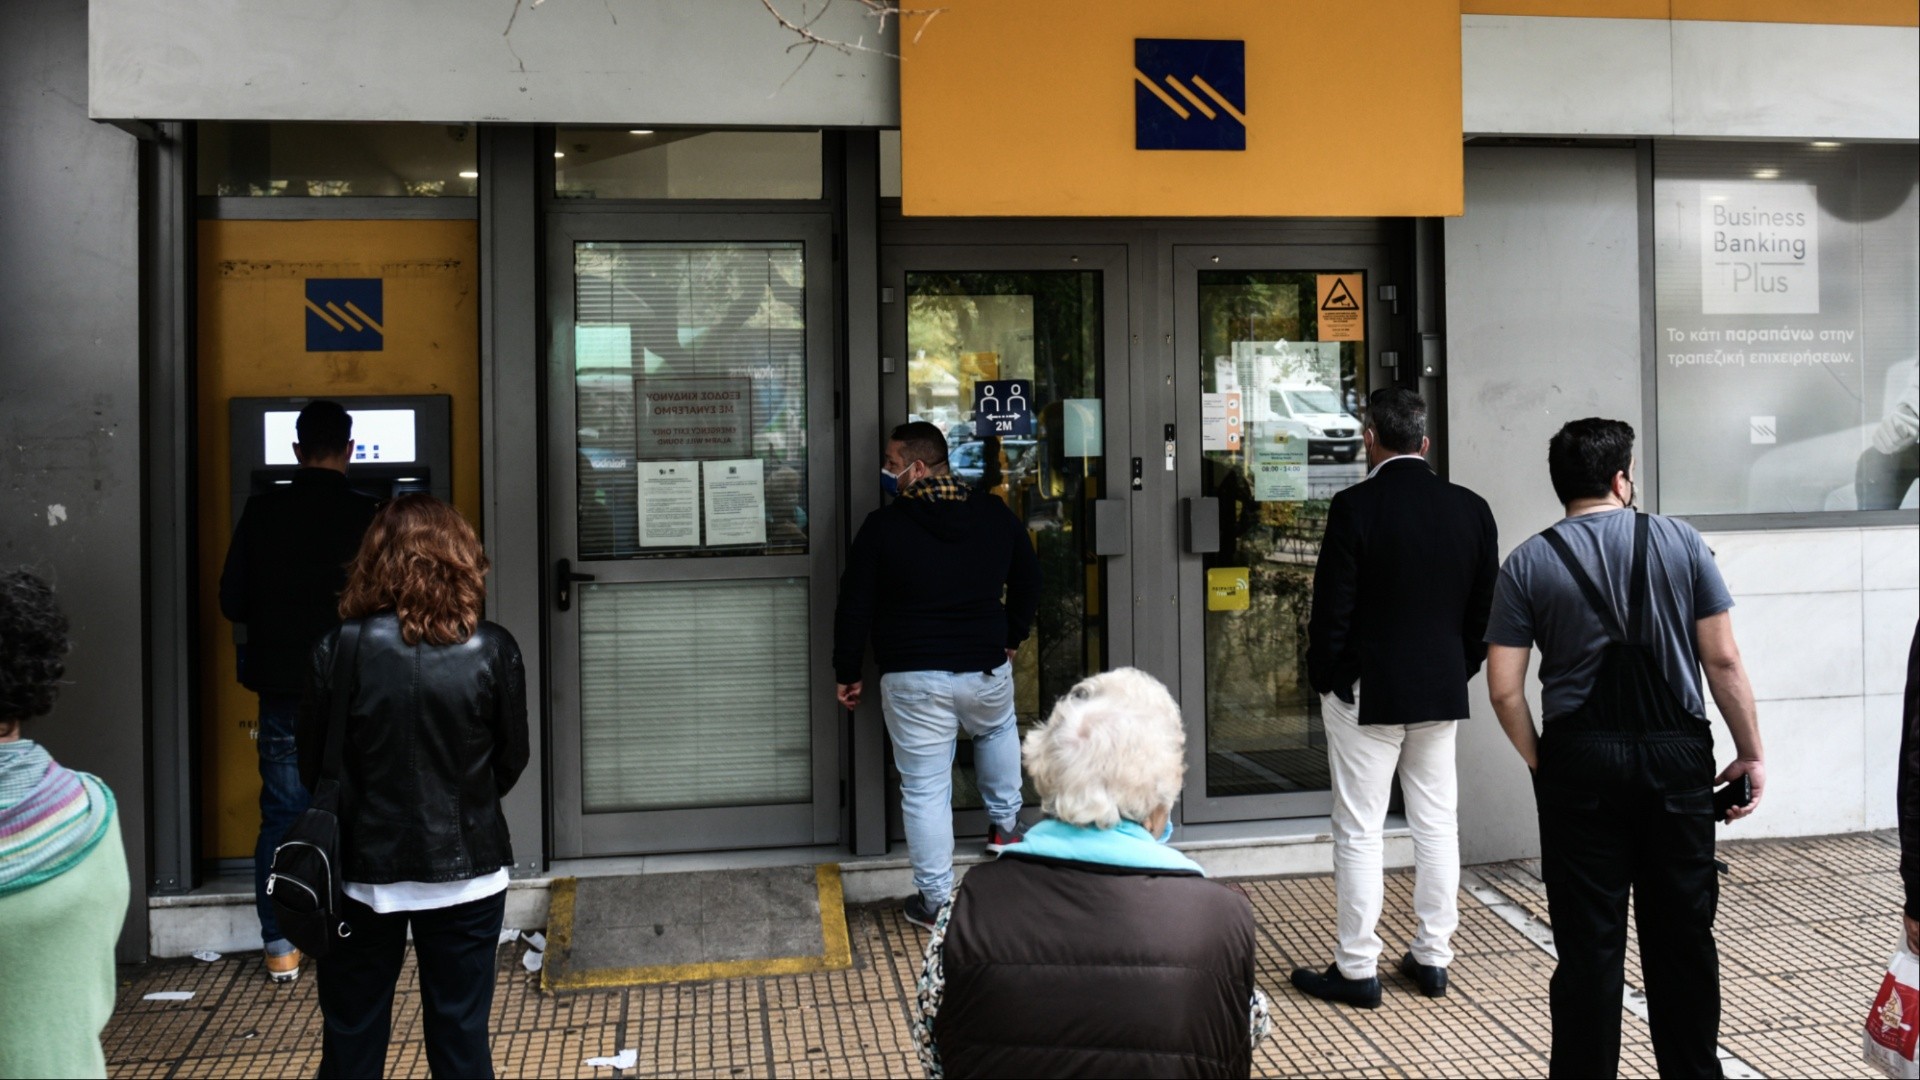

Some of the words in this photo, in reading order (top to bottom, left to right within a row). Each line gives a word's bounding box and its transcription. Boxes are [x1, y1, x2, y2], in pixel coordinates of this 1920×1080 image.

[1714, 205, 1805, 227] Business
[1714, 231, 1805, 260] Banking
[1667, 328, 1685, 342] Το
[1690, 327, 1720, 342] κάτι
[1726, 326, 1814, 345] παραπάνω
[1820, 330, 1854, 345] στην
[1667, 350, 1745, 368] τραπεζική
[1750, 349, 1854, 367] επιχειρήσεων.
[995, 420, 1012, 431] 2M
